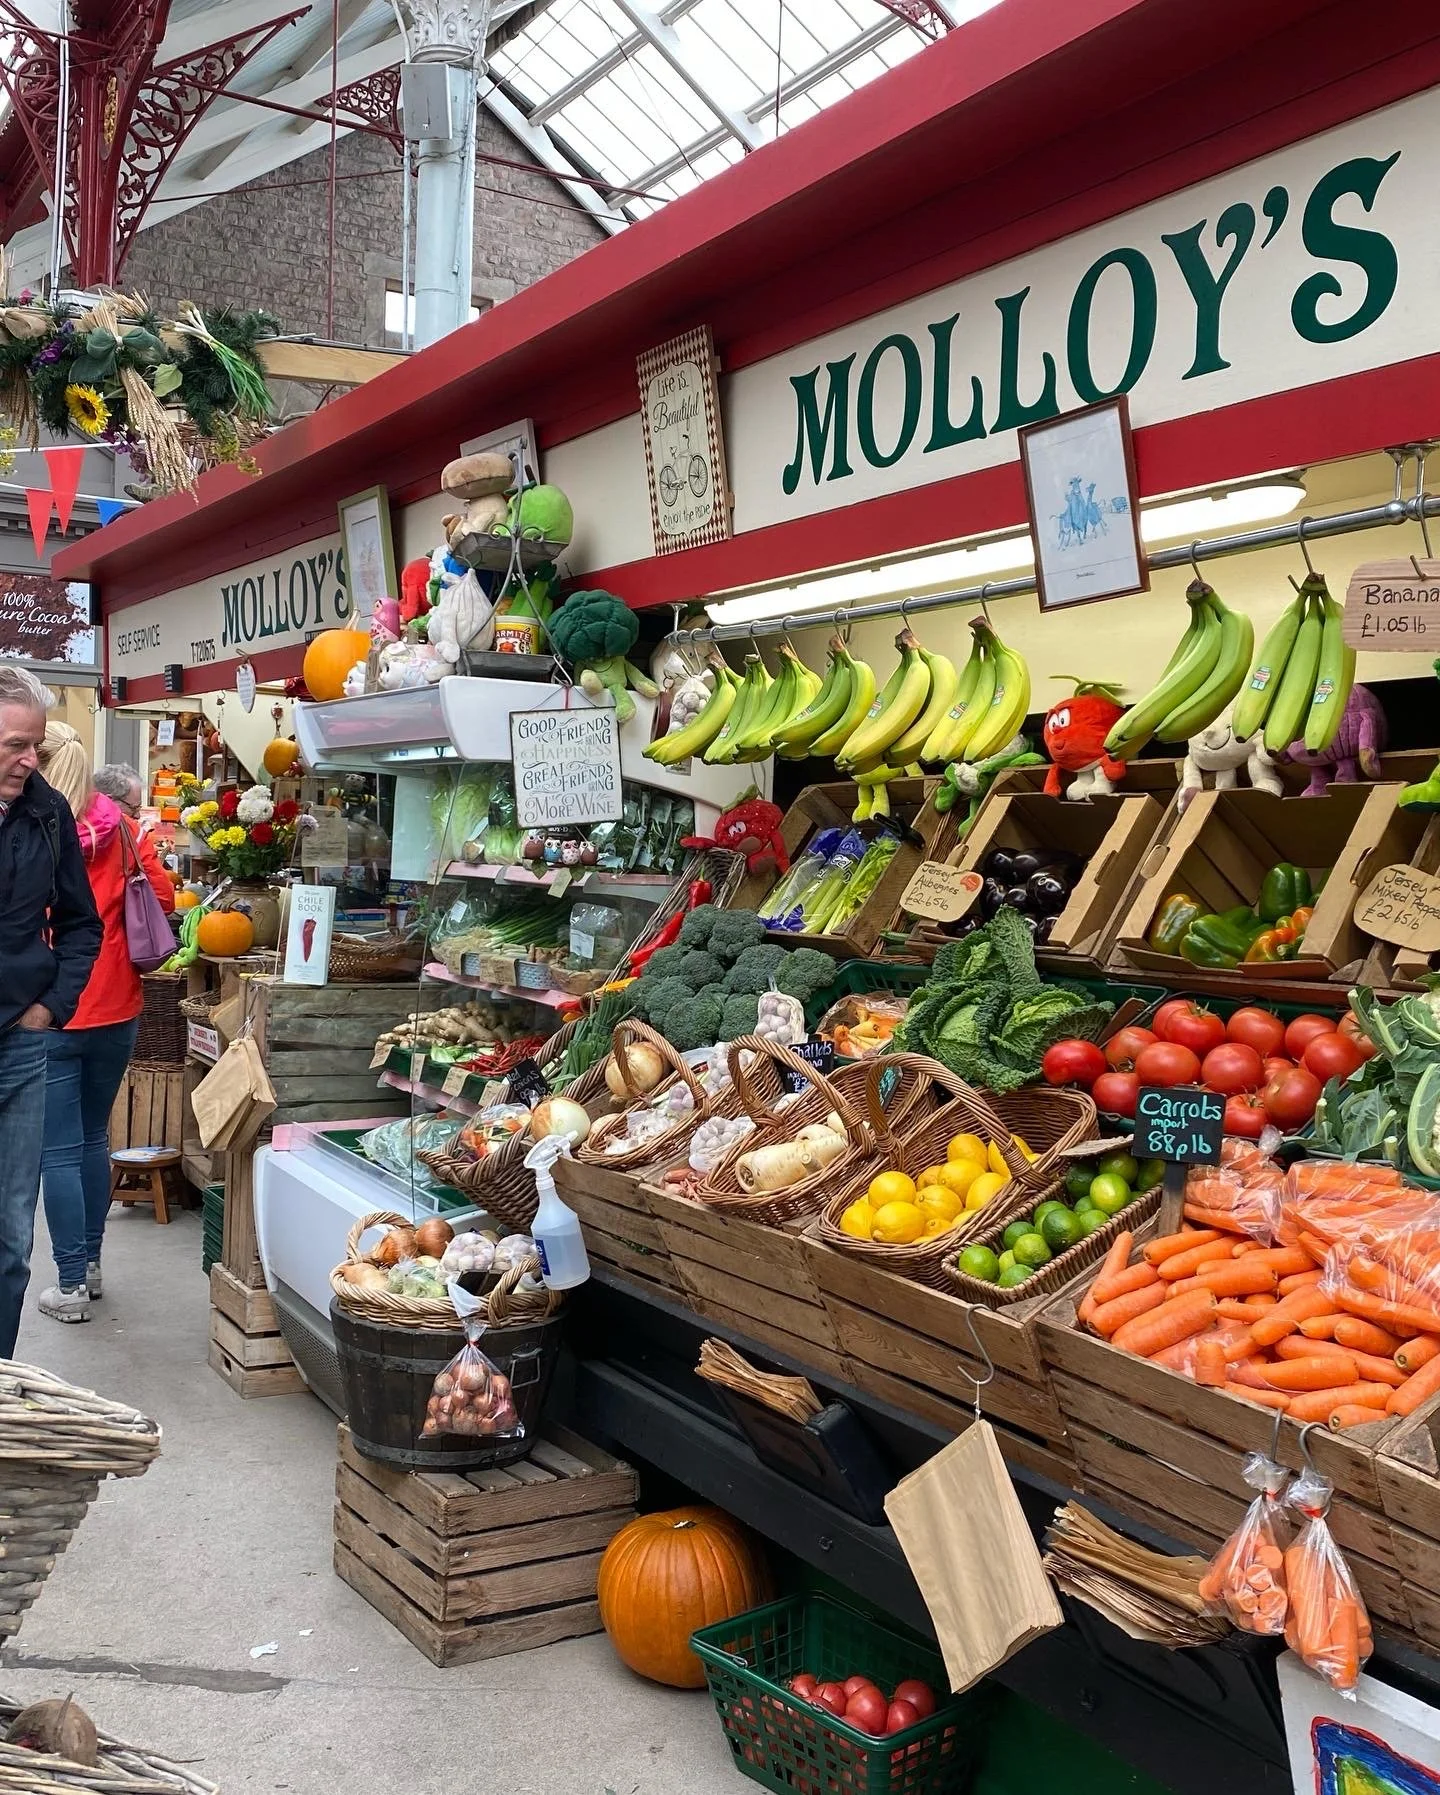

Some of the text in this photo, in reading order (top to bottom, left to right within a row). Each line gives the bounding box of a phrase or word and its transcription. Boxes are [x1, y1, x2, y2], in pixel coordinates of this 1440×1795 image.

[783, 150, 1401, 495] MOLLOY'S
[657, 376, 677, 399] Life
[653, 391, 700, 433] Beautiful
[683, 507, 694, 525] the
[3, 592, 35, 609] 100%
[220, 546, 350, 648] MOLLOY'S
[28, 606, 72, 624] Cocoa
[17, 621, 52, 635] butter
[496, 630, 531, 641] ARMITE
[1361, 613, 1427, 638] £1.05 lb
[117, 623, 161, 656] SELF SERVICE
[518, 714, 611, 745] GOOD FRIENDS
[585, 728, 611, 745] BRING
[533, 743, 612, 760] HAPPINESS
[522, 760, 613, 792] GREAT FRIENDS
[588, 774, 614, 792] BRING
[527, 793, 616, 822] MORE WINE
[921, 863, 951, 883] Jersey
[1384, 867, 1428, 898] Jersey
[297, 895, 325, 905] CHILE
[1371, 883, 1411, 903] Mixed
[297, 904, 323, 913] BOOK
[1140, 1093, 1222, 1120] Carrots
[1151, 1117, 1189, 1134] import
[1148, 1131, 1213, 1161] 88p lb
